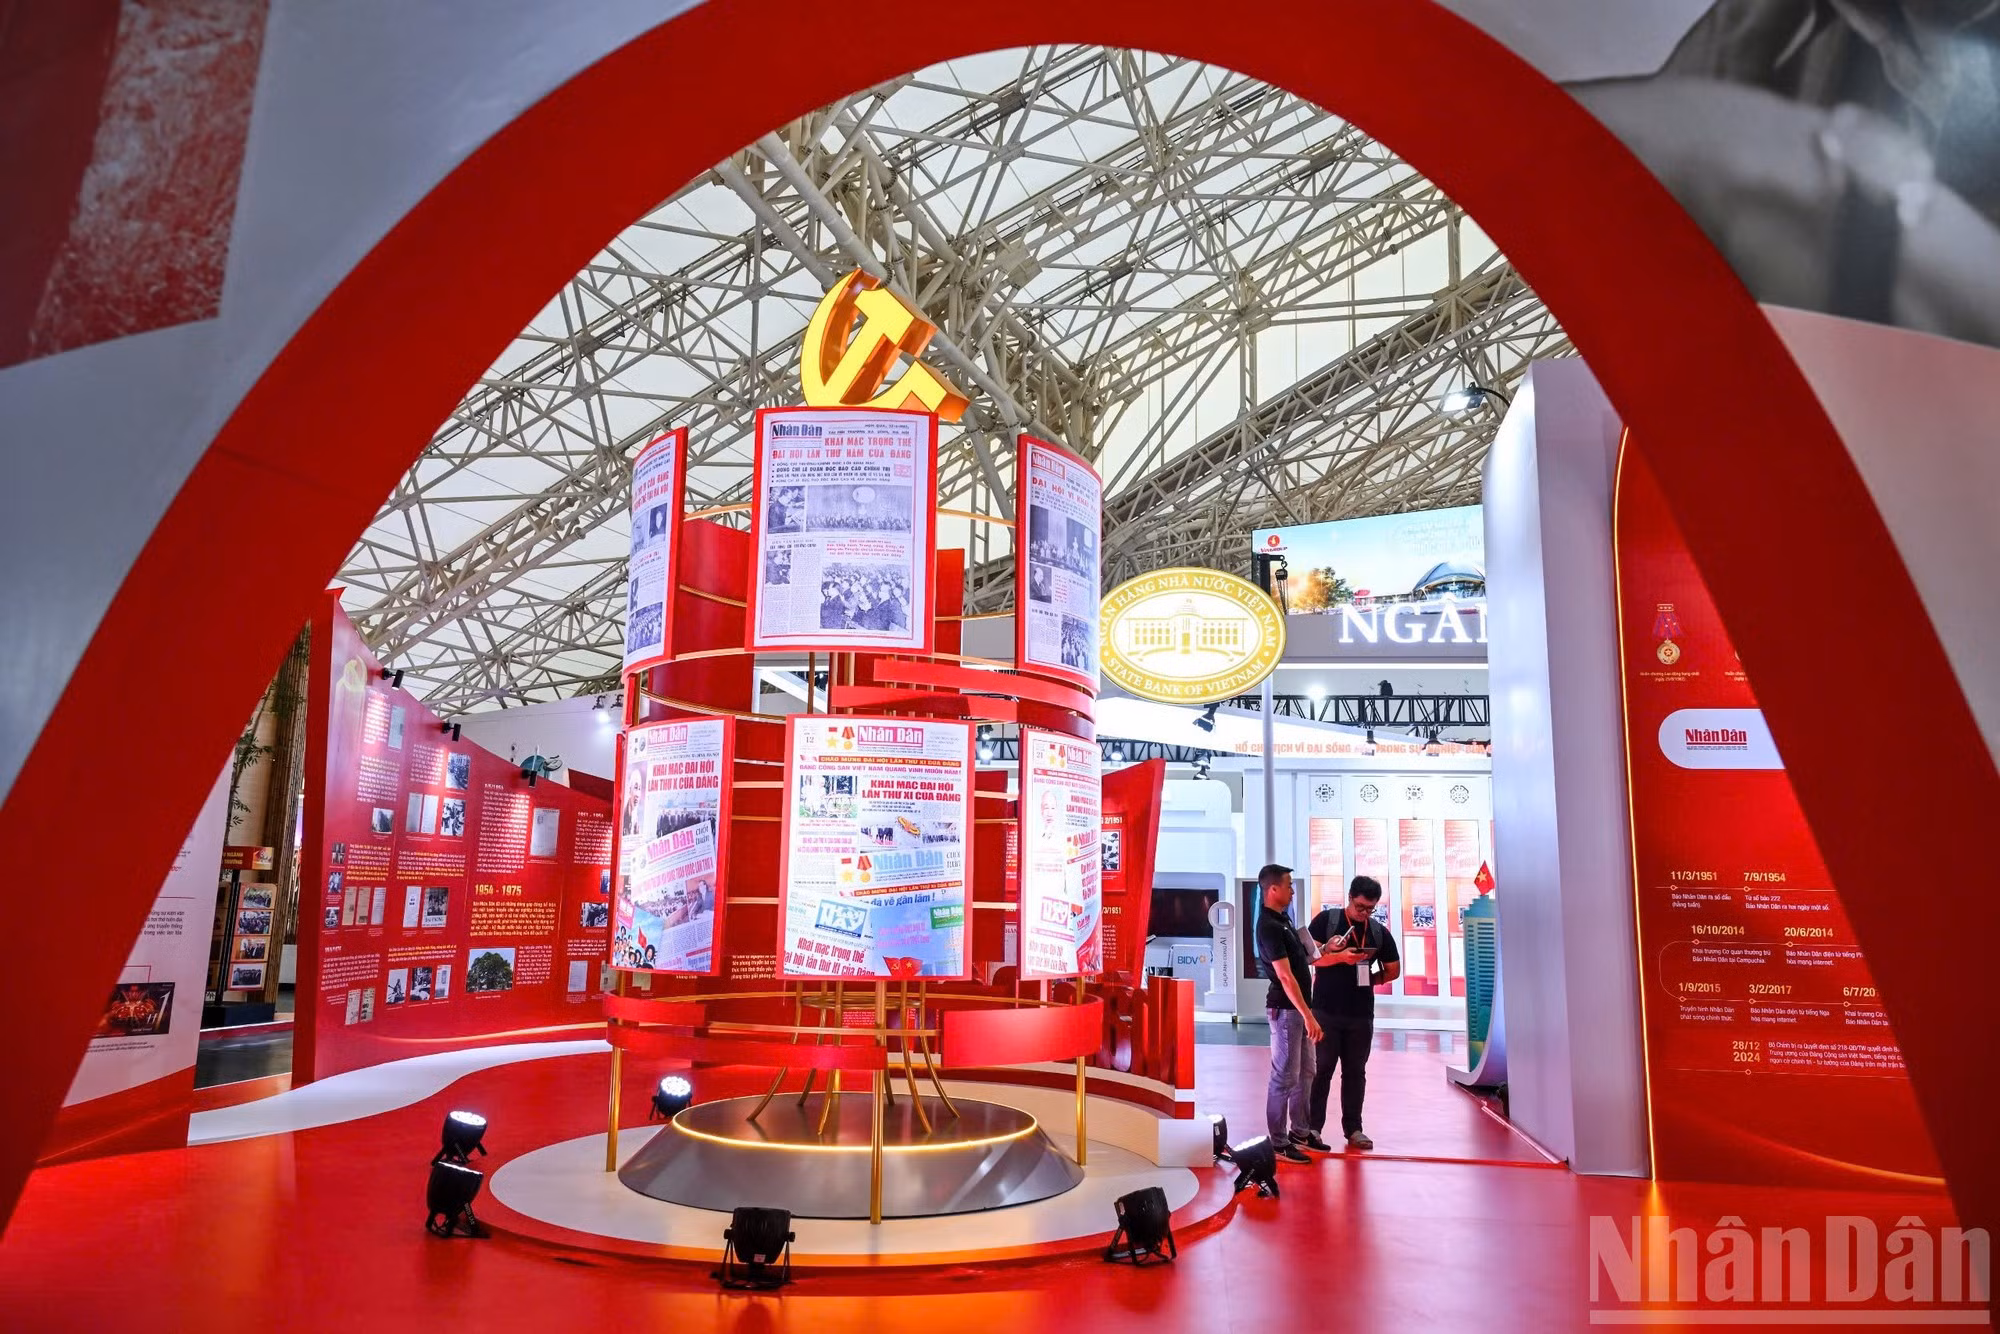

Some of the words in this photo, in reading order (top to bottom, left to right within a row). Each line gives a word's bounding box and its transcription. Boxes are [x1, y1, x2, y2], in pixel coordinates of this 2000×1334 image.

[772, 424, 799, 436] Nhân
[801, 424, 822, 436] Dân
[1100, 607, 1116, 646] NGÂN
[1115, 582, 1156, 607] HÀNG
[1158, 576, 1189, 589] NHÀ
[1193, 574, 1233, 594] NƯỚC
[1237, 589, 1266, 613] VIỆT
[1263, 612, 1277, 647] NAM
[1338, 592, 1488, 643] NGÂ
[1107, 658, 1142, 685] STATE
[1145, 679, 1181, 695] BANK
[1184, 684, 1203, 695] OF
[1206, 661, 1265, 692] VIETNAM
[669, 726, 687, 741] Dân
[859, 727, 894, 743] Nhân
[897, 728, 922, 744] Dân
[1685, 729, 1720, 742] Nhân
[1720, 729, 1747, 742] Dân
[1235, 741, 1248, 752] HỒ
[1251, 743, 1264, 752] CH
[1295, 742, 1304, 752] VĨ
[1326, 741, 1351, 752] SỐNG
[653, 764, 667, 776] KHAI
[668, 763, 684, 775] MẠC
[685, 762, 698, 774] ĐẠI
[700, 760, 714, 773] HỘI
[648, 779, 658, 791] LẦN
[659, 778, 672, 790] THỨ
[679, 777, 694, 789] CỦA
[695, 774, 719, 788] ĐẢNG
[871, 780, 894, 789] KHAI
[897, 781, 918, 790] MẠC
[920, 782, 936, 791] ĐẠI
[938, 782, 953, 791] HỘI
[862, 790, 880, 799] LẦN
[883, 791, 902, 799] THỨ
[904, 791, 913, 799] XI
[915, 792, 934, 800] CỦA
[936, 792, 961, 801] ĐẢNG
[672, 830, 694, 849] Dân
[873, 854, 912, 870] Nhân
[915, 850, 943, 866] Dân
[1671, 871, 1717, 880] 11/3/1951
[1744, 872, 1786, 882] 7/9/1954
[475, 884, 493, 895] 1954
[502, 884, 522, 895] 1975
[896, 895, 913, 906] gần
[914, 894, 930, 903] lắm
[1691, 925, 1745, 935] 16/10/2014
[1784, 927, 1833, 937] 20/6/2014
[798, 938, 814, 951] Khai
[815, 943, 830, 957] mạc
[831, 945, 851, 961] trọng
[852, 948, 867, 963] thể
[793, 952, 805, 968] hội
[806, 954, 817, 969] lần
[819, 958, 831, 972] thứ
[1178, 956, 1198, 964] BIDV
[1679, 982, 1721, 992] 1/9/2015
[1749, 984, 1792, 994] 3/2/2017
[1733, 1041, 1760, 1050] 28/12
[1733, 1052, 1760, 1062] 2024
